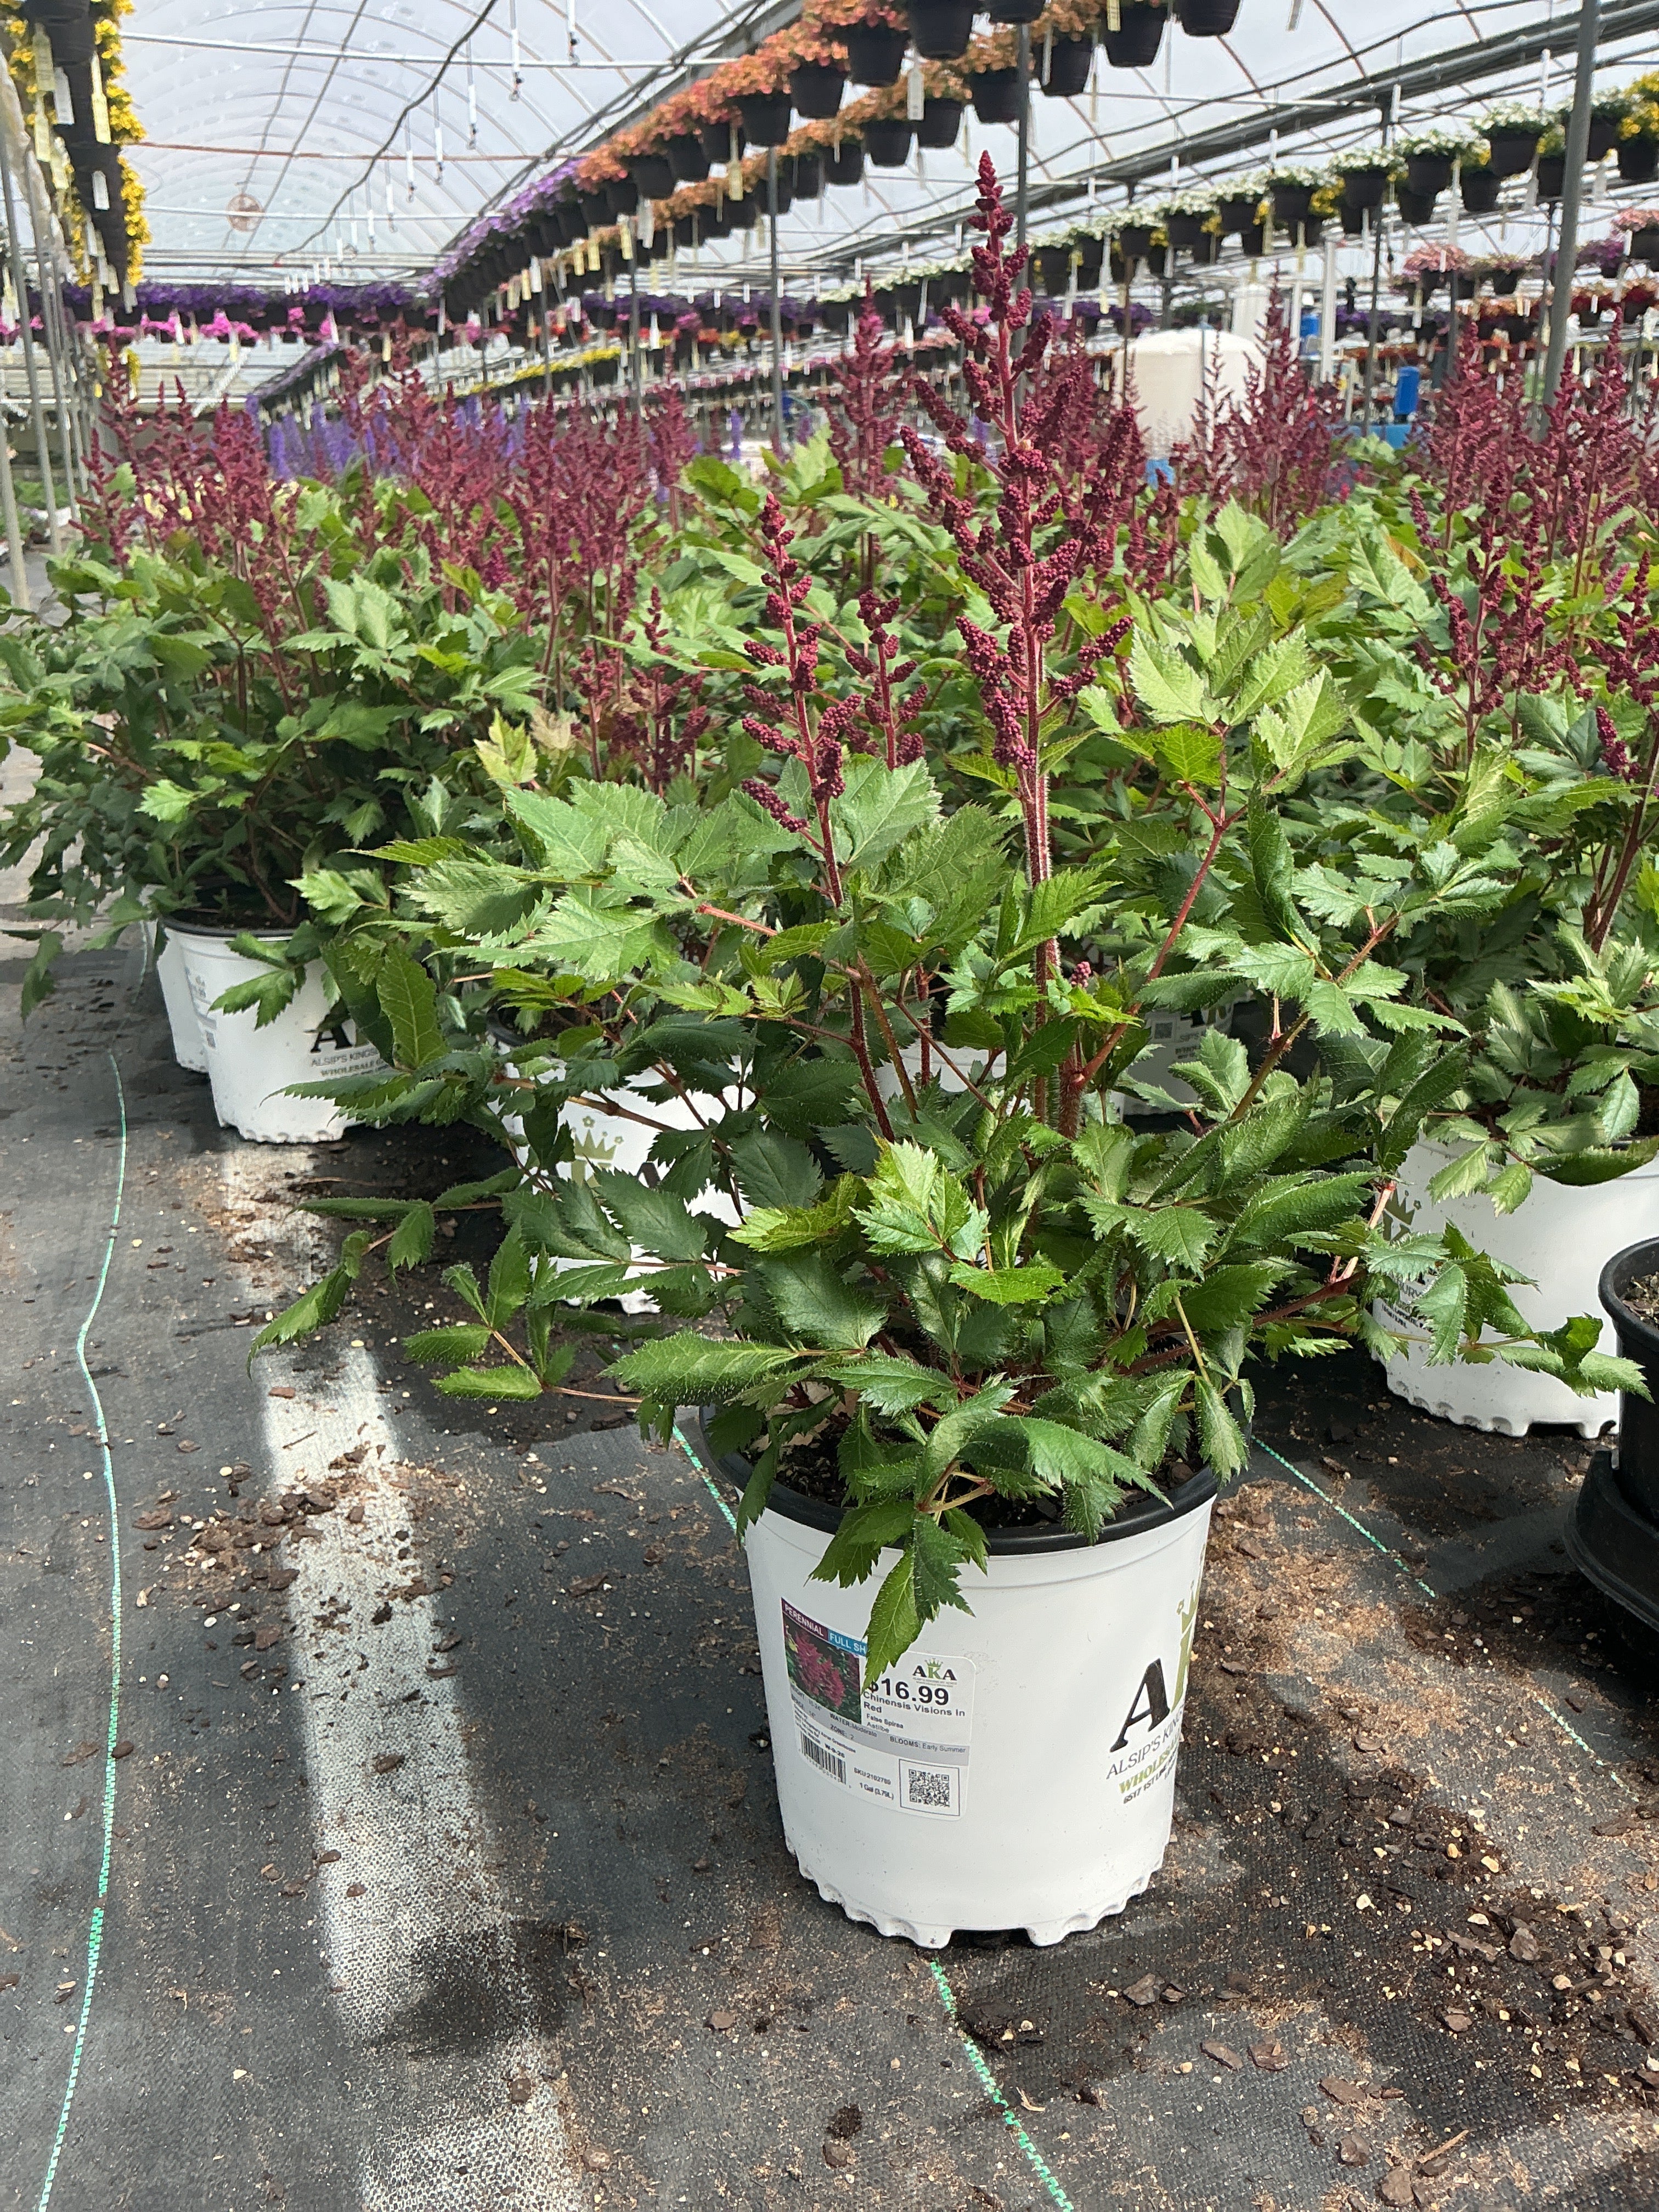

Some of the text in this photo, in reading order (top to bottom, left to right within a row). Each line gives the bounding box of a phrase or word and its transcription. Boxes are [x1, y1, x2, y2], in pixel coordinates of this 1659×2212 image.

[785, 1604, 824, 1637] PERENNIAL
[830, 1633, 866, 1654] FULL SH
[912, 1663, 957, 1681] AKA
[868, 1678, 949, 1706] $16.99
[863, 1691, 911, 1710] Chinensis
[913, 1703, 952, 1716] Visions
[864, 1701, 882, 1713] Red
[866, 1713, 904, 1729] False Spirea
[867, 1722, 890, 1733] Astilbe
[922, 1743, 938, 1752] Early
[939, 1745, 966, 1753] Summer
[1105, 1735, 1161, 1780] ALSIP'S
